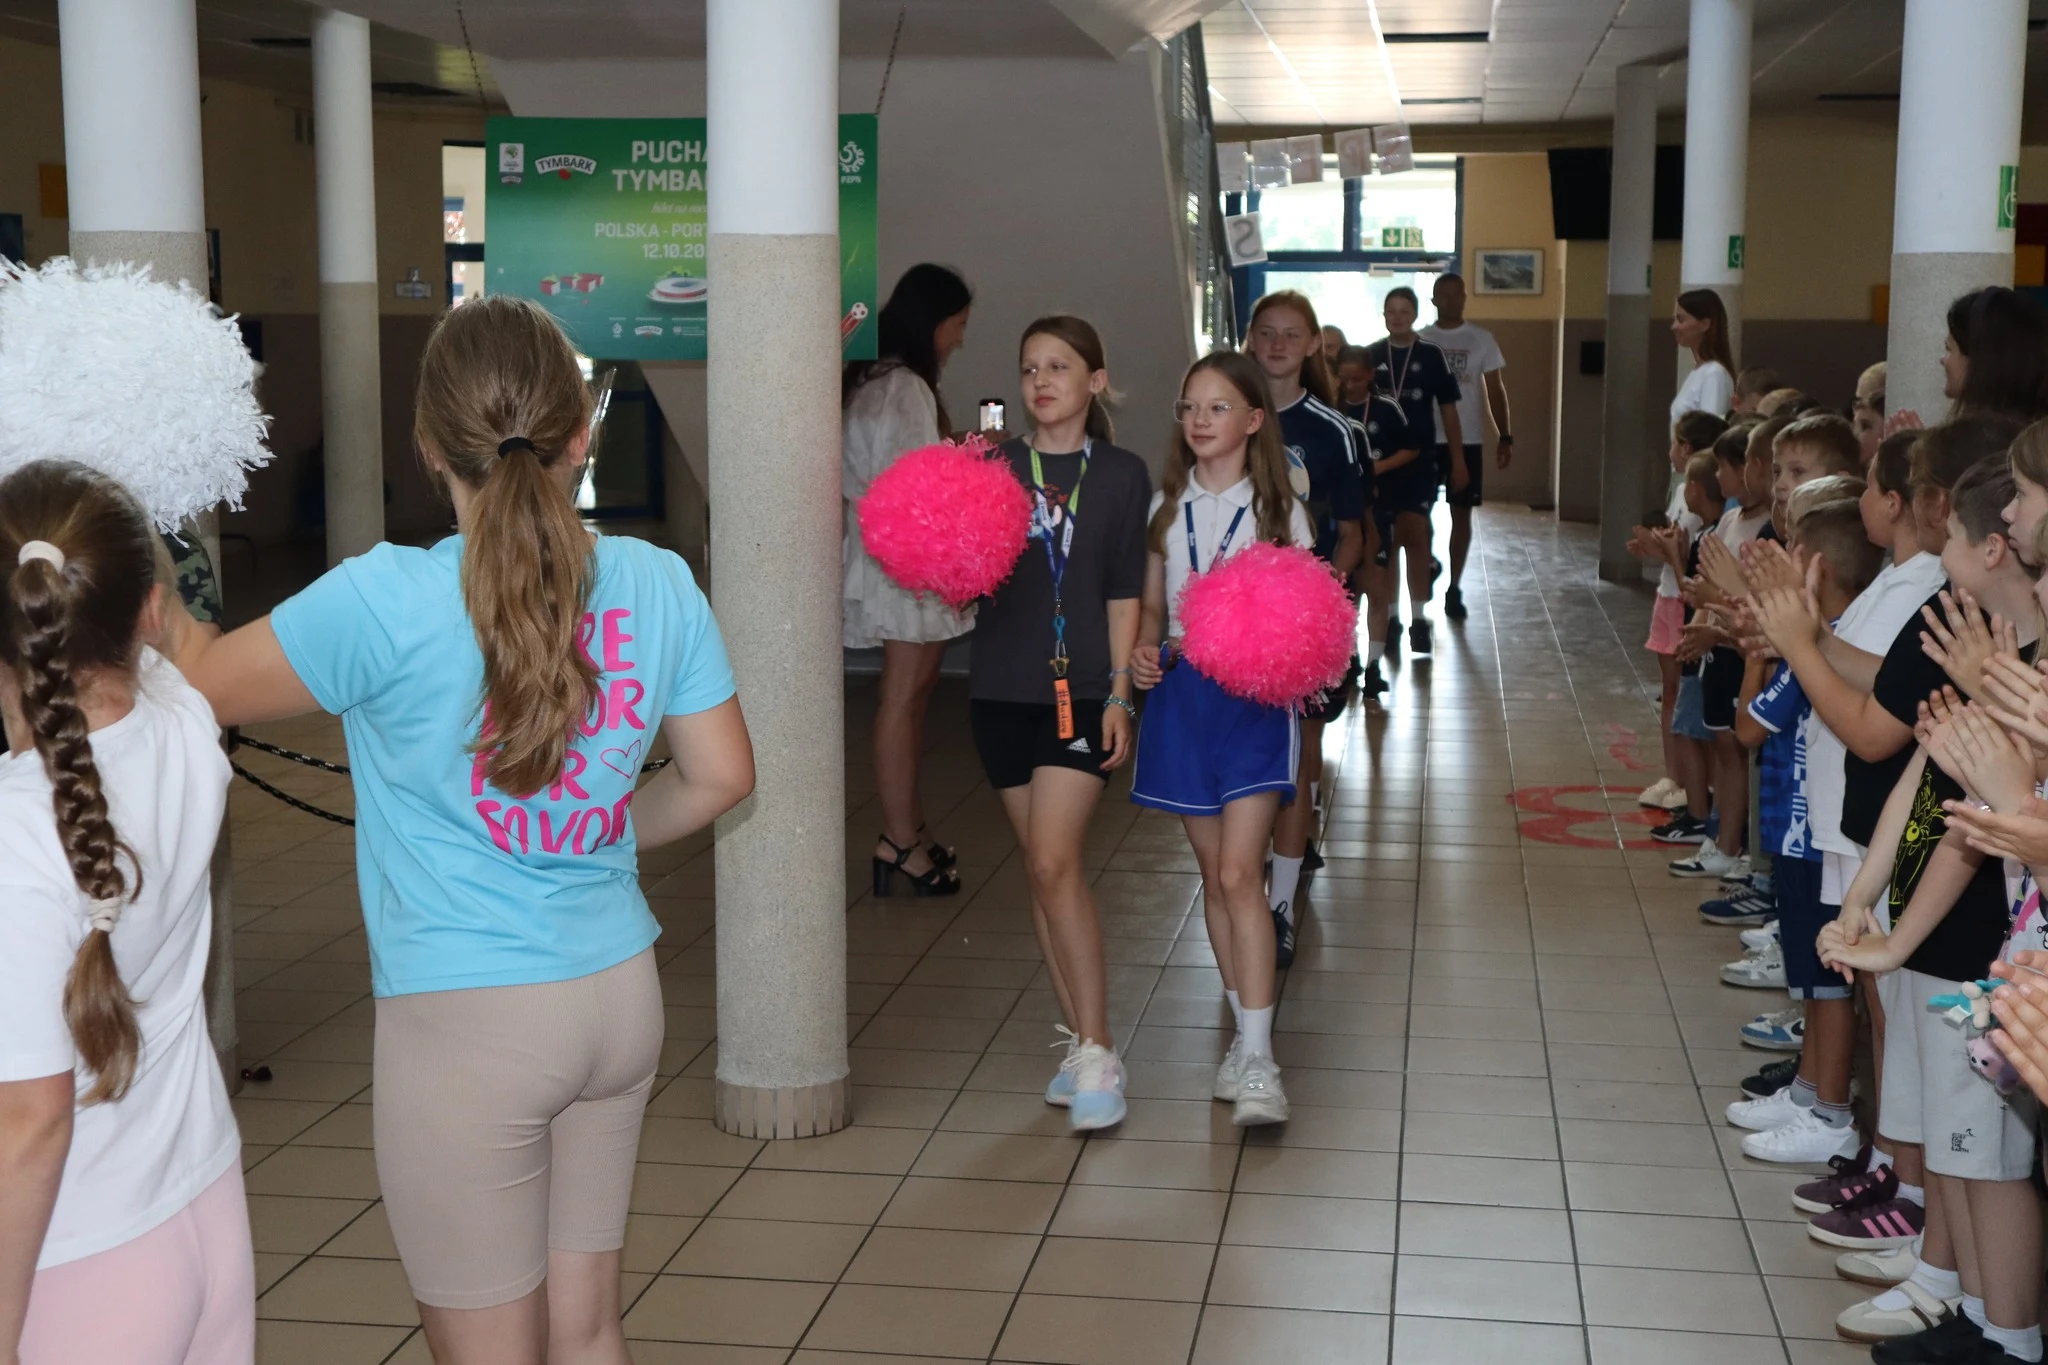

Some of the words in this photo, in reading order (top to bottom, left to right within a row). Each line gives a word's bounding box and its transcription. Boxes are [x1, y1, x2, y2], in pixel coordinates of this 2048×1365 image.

[538, 156, 595, 172] TYMBARK
[611, 168, 707, 192] TYMBA
[595, 222, 660, 237] POLSKA
[642, 243, 706, 258] 12.10.20
